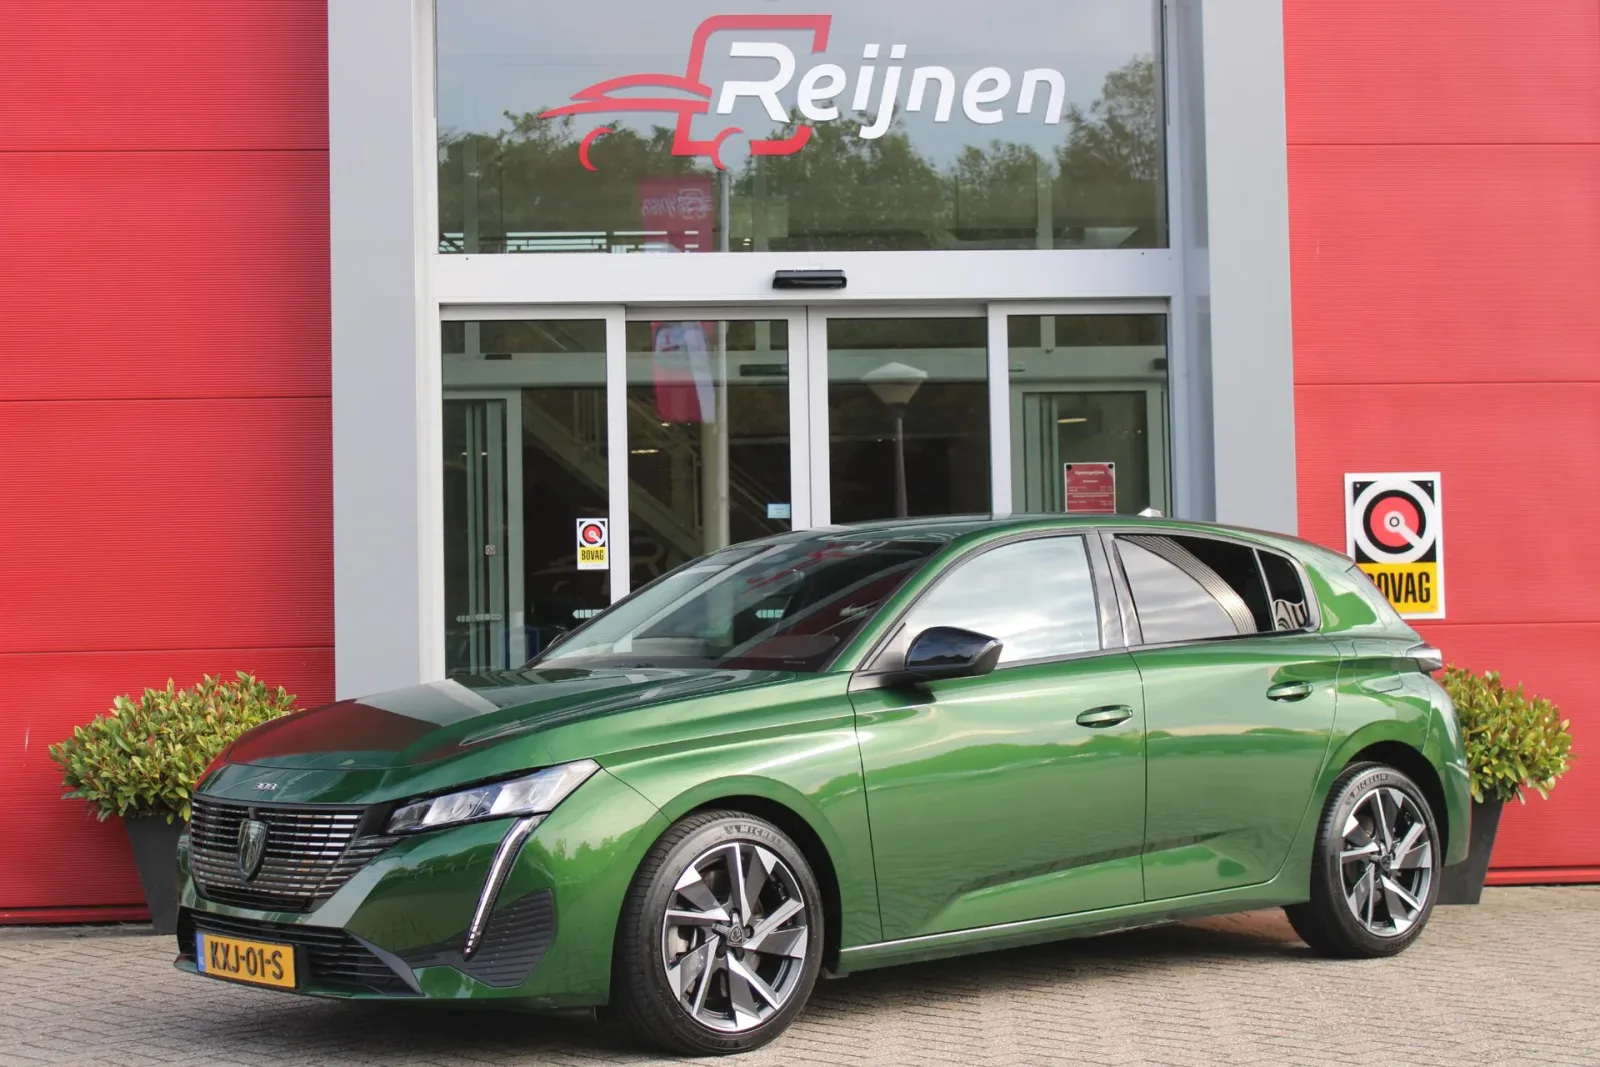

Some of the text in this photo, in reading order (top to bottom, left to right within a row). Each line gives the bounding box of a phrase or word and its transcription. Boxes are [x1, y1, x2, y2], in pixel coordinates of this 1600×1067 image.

[716, 41, 1066, 140] Reijnen
[581, 549, 604, 561] BOVAG
[1368, 571, 1430, 604] OVAG
[210, 940, 284, 980] KXJ-01-S
